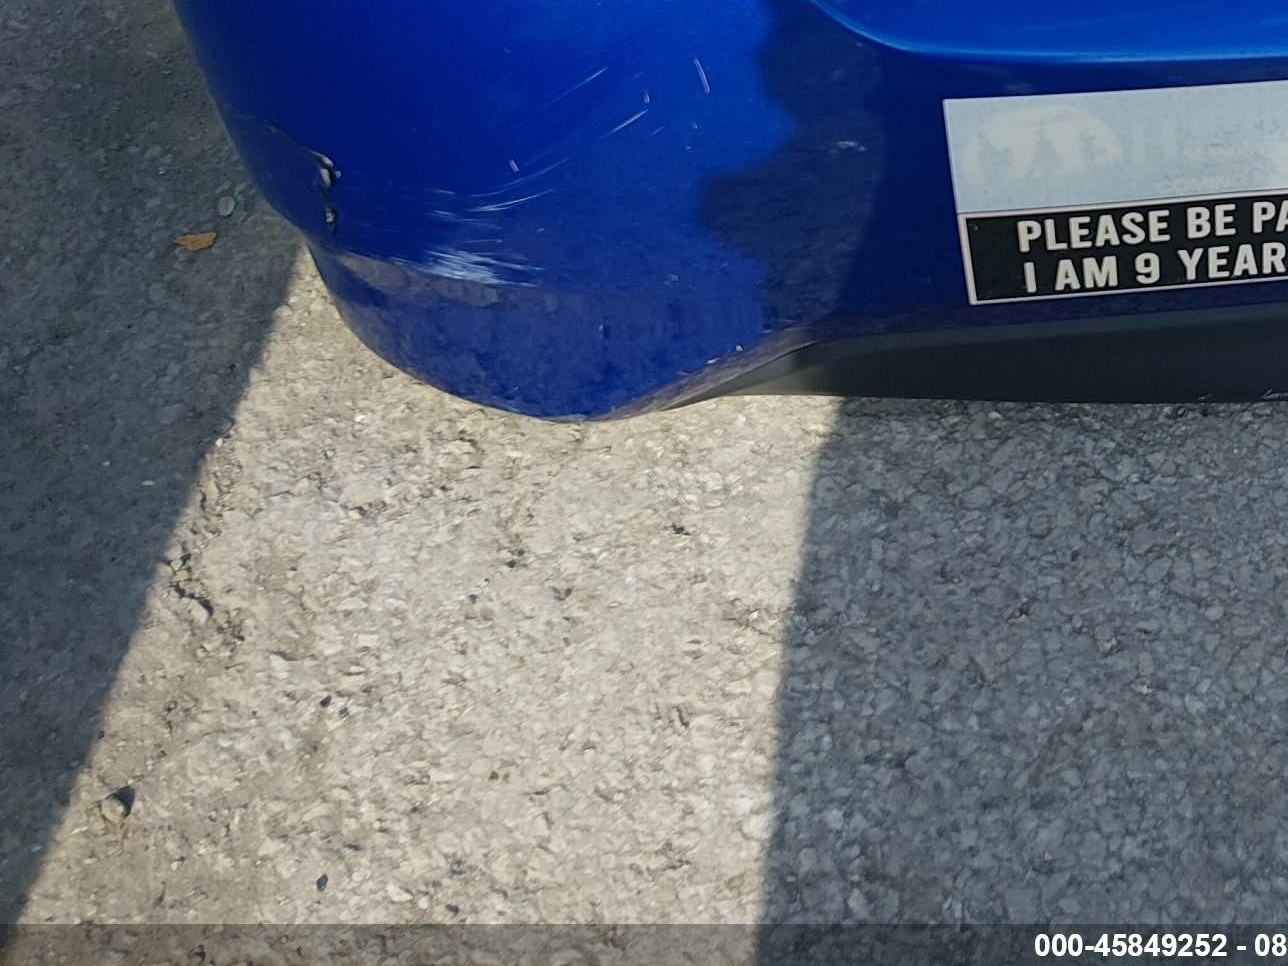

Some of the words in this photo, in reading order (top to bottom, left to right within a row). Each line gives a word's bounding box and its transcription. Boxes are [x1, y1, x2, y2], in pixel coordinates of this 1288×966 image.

[1017, 209, 1171, 253] PLEASE
[1186, 204, 1237, 239] BE
[1023, 261, 1038, 294] I
[1054, 255, 1119, 291] AM
[1134, 252, 1161, 284] 9
